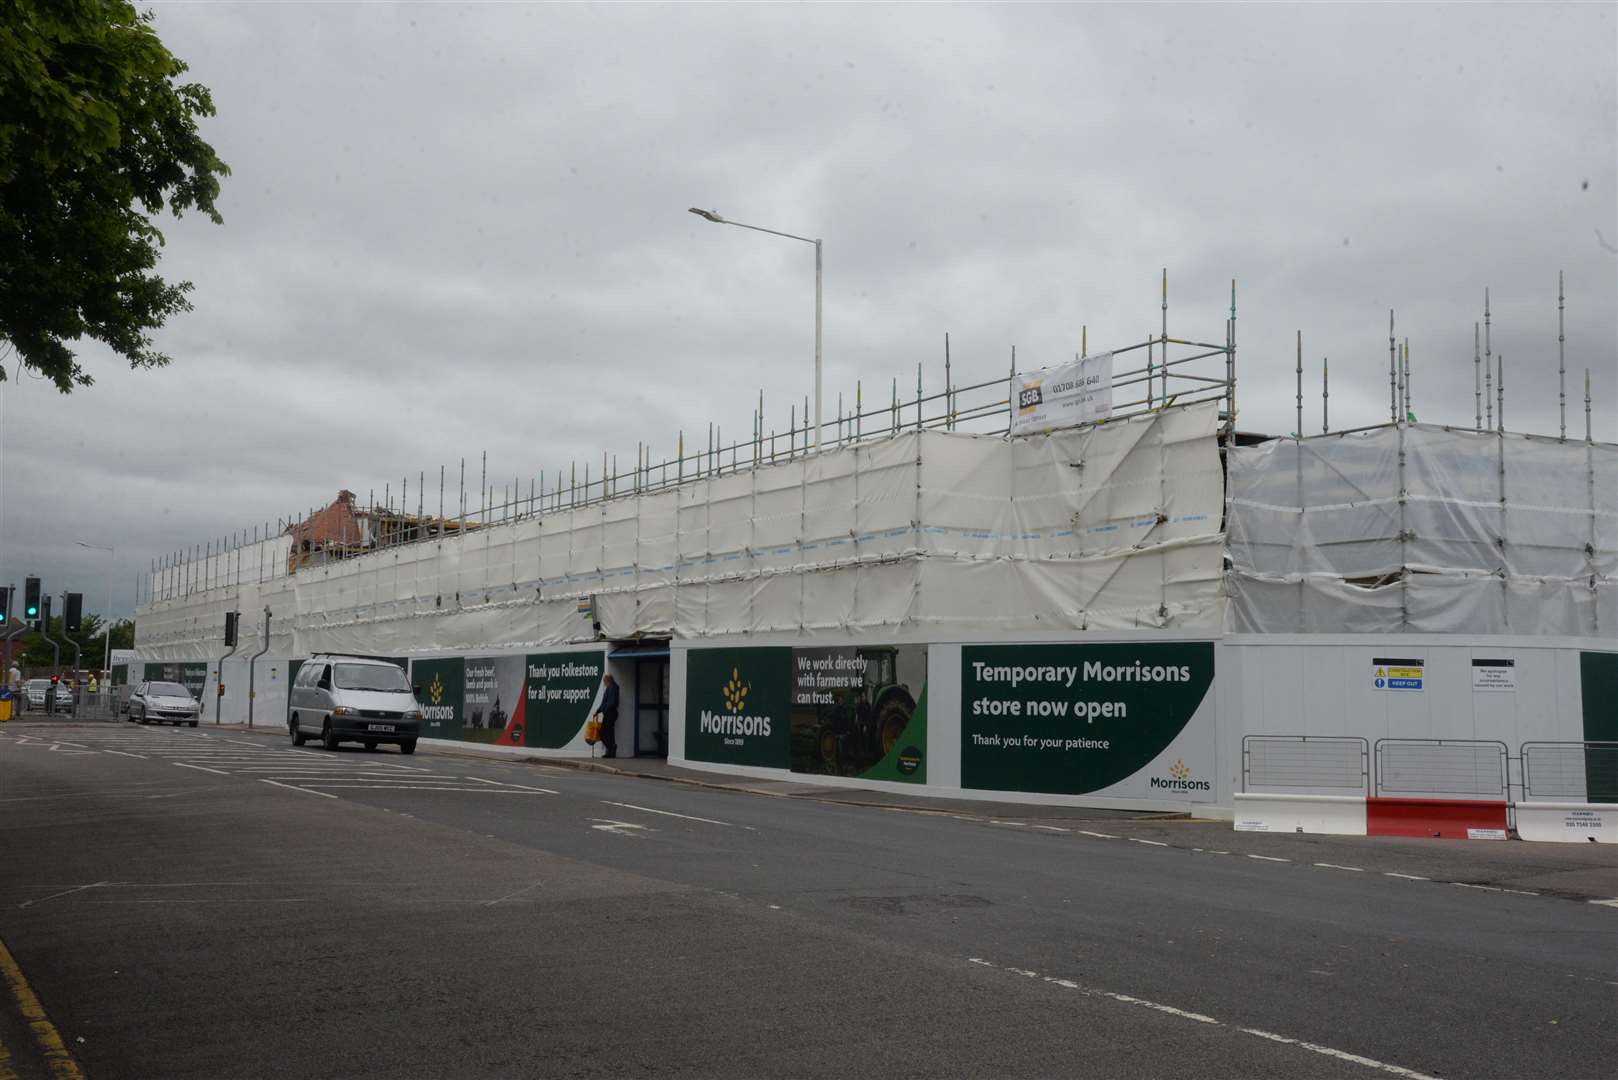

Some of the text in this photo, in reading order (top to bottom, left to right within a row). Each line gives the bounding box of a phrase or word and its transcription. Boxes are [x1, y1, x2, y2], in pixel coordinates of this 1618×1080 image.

[1021, 390, 1040, 407] SGB
[528, 662, 598, 681] Thank you Folkestone
[798, 654, 868, 674] We work directly
[797, 672, 863, 688] with farmers we
[973, 660, 1191, 688] Temporary Morrisons
[528, 686, 590, 703] for all your support
[797, 690, 835, 705] can trust.
[418, 702, 454, 721] Morrisons
[973, 697, 1127, 723] store now open
[701, 709, 771, 737] Morrisons
[972, 734, 1110, 750] Thank you for your patience
[1150, 776, 1210, 791] Morrisons
